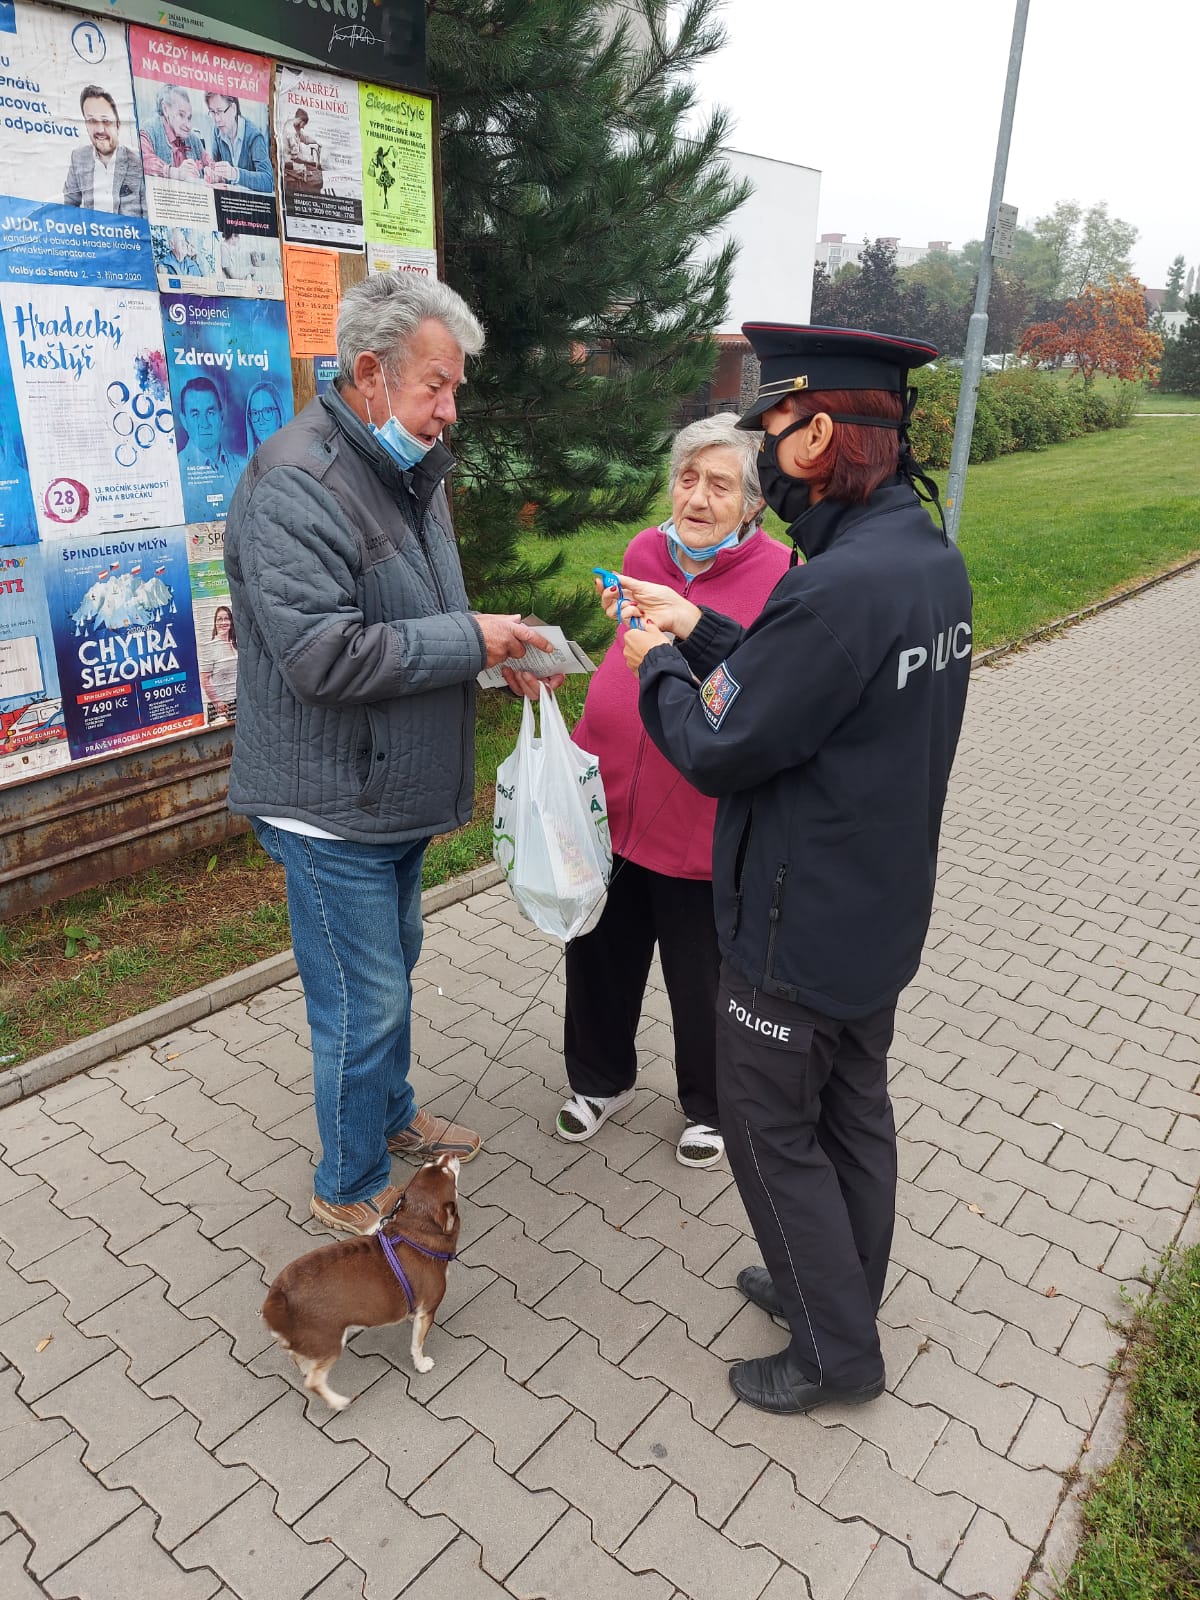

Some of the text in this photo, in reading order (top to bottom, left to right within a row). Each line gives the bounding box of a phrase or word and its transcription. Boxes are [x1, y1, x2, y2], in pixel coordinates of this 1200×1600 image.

[148, 40, 253, 74] KAŽDÝ MÁ PRÁVO
[142, 57, 259, 93] NA DŮSTOJNÉ STÁŘÍ
[298, 80, 339, 99] NÁBŘEŽÍ
[5, 116, 79, 138] odpočívat
[1, 216, 140, 240] JUDr. Pavel Staněk
[8, 264, 34, 277] Volby
[35, 267, 46, 276] do
[48, 268, 79, 279] Senátu
[188, 305, 230, 319] Spojenci
[12, 302, 123, 350] Hradecký
[20, 340, 95, 381] koštýř
[173, 347, 269, 371] Zdravý kraj
[54, 490, 75, 506] 28
[95, 494, 113, 502] VÍNA
[105, 483, 132, 492] ROČNÍK
[62, 542, 134, 561] ŠPINDLERŮV
[138, 539, 167, 552] MLÝN
[78, 624, 177, 666] CHYTRÁ
[897, 621, 972, 690] PLIC
[81, 651, 180, 689] SEZÓNKA
[145, 683, 186, 702] 9 900 Kč
[82, 697, 128, 716] 7 490 Kč
[728, 998, 791, 1042] POLICIE
